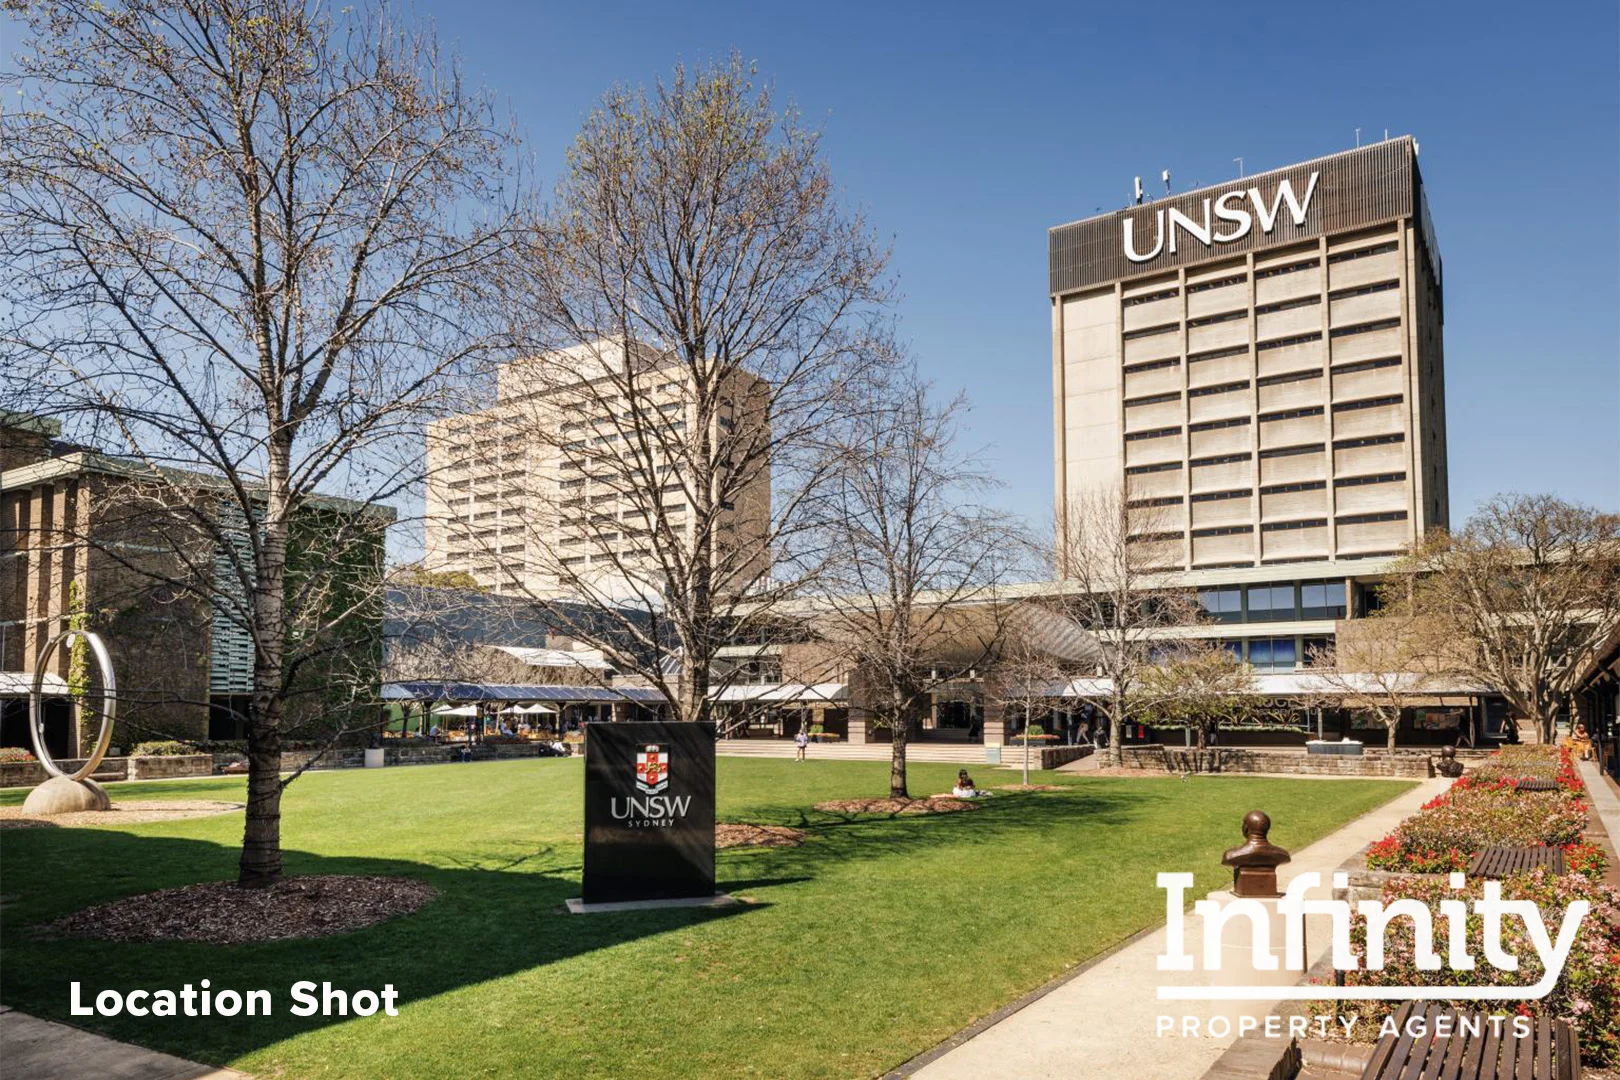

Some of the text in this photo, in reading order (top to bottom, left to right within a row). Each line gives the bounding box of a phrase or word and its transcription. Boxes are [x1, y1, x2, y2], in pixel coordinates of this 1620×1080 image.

[1123, 171, 1320, 263] UNSW
[611, 795, 691, 819] UNSW
[628, 818, 675, 828] SYDNEY
